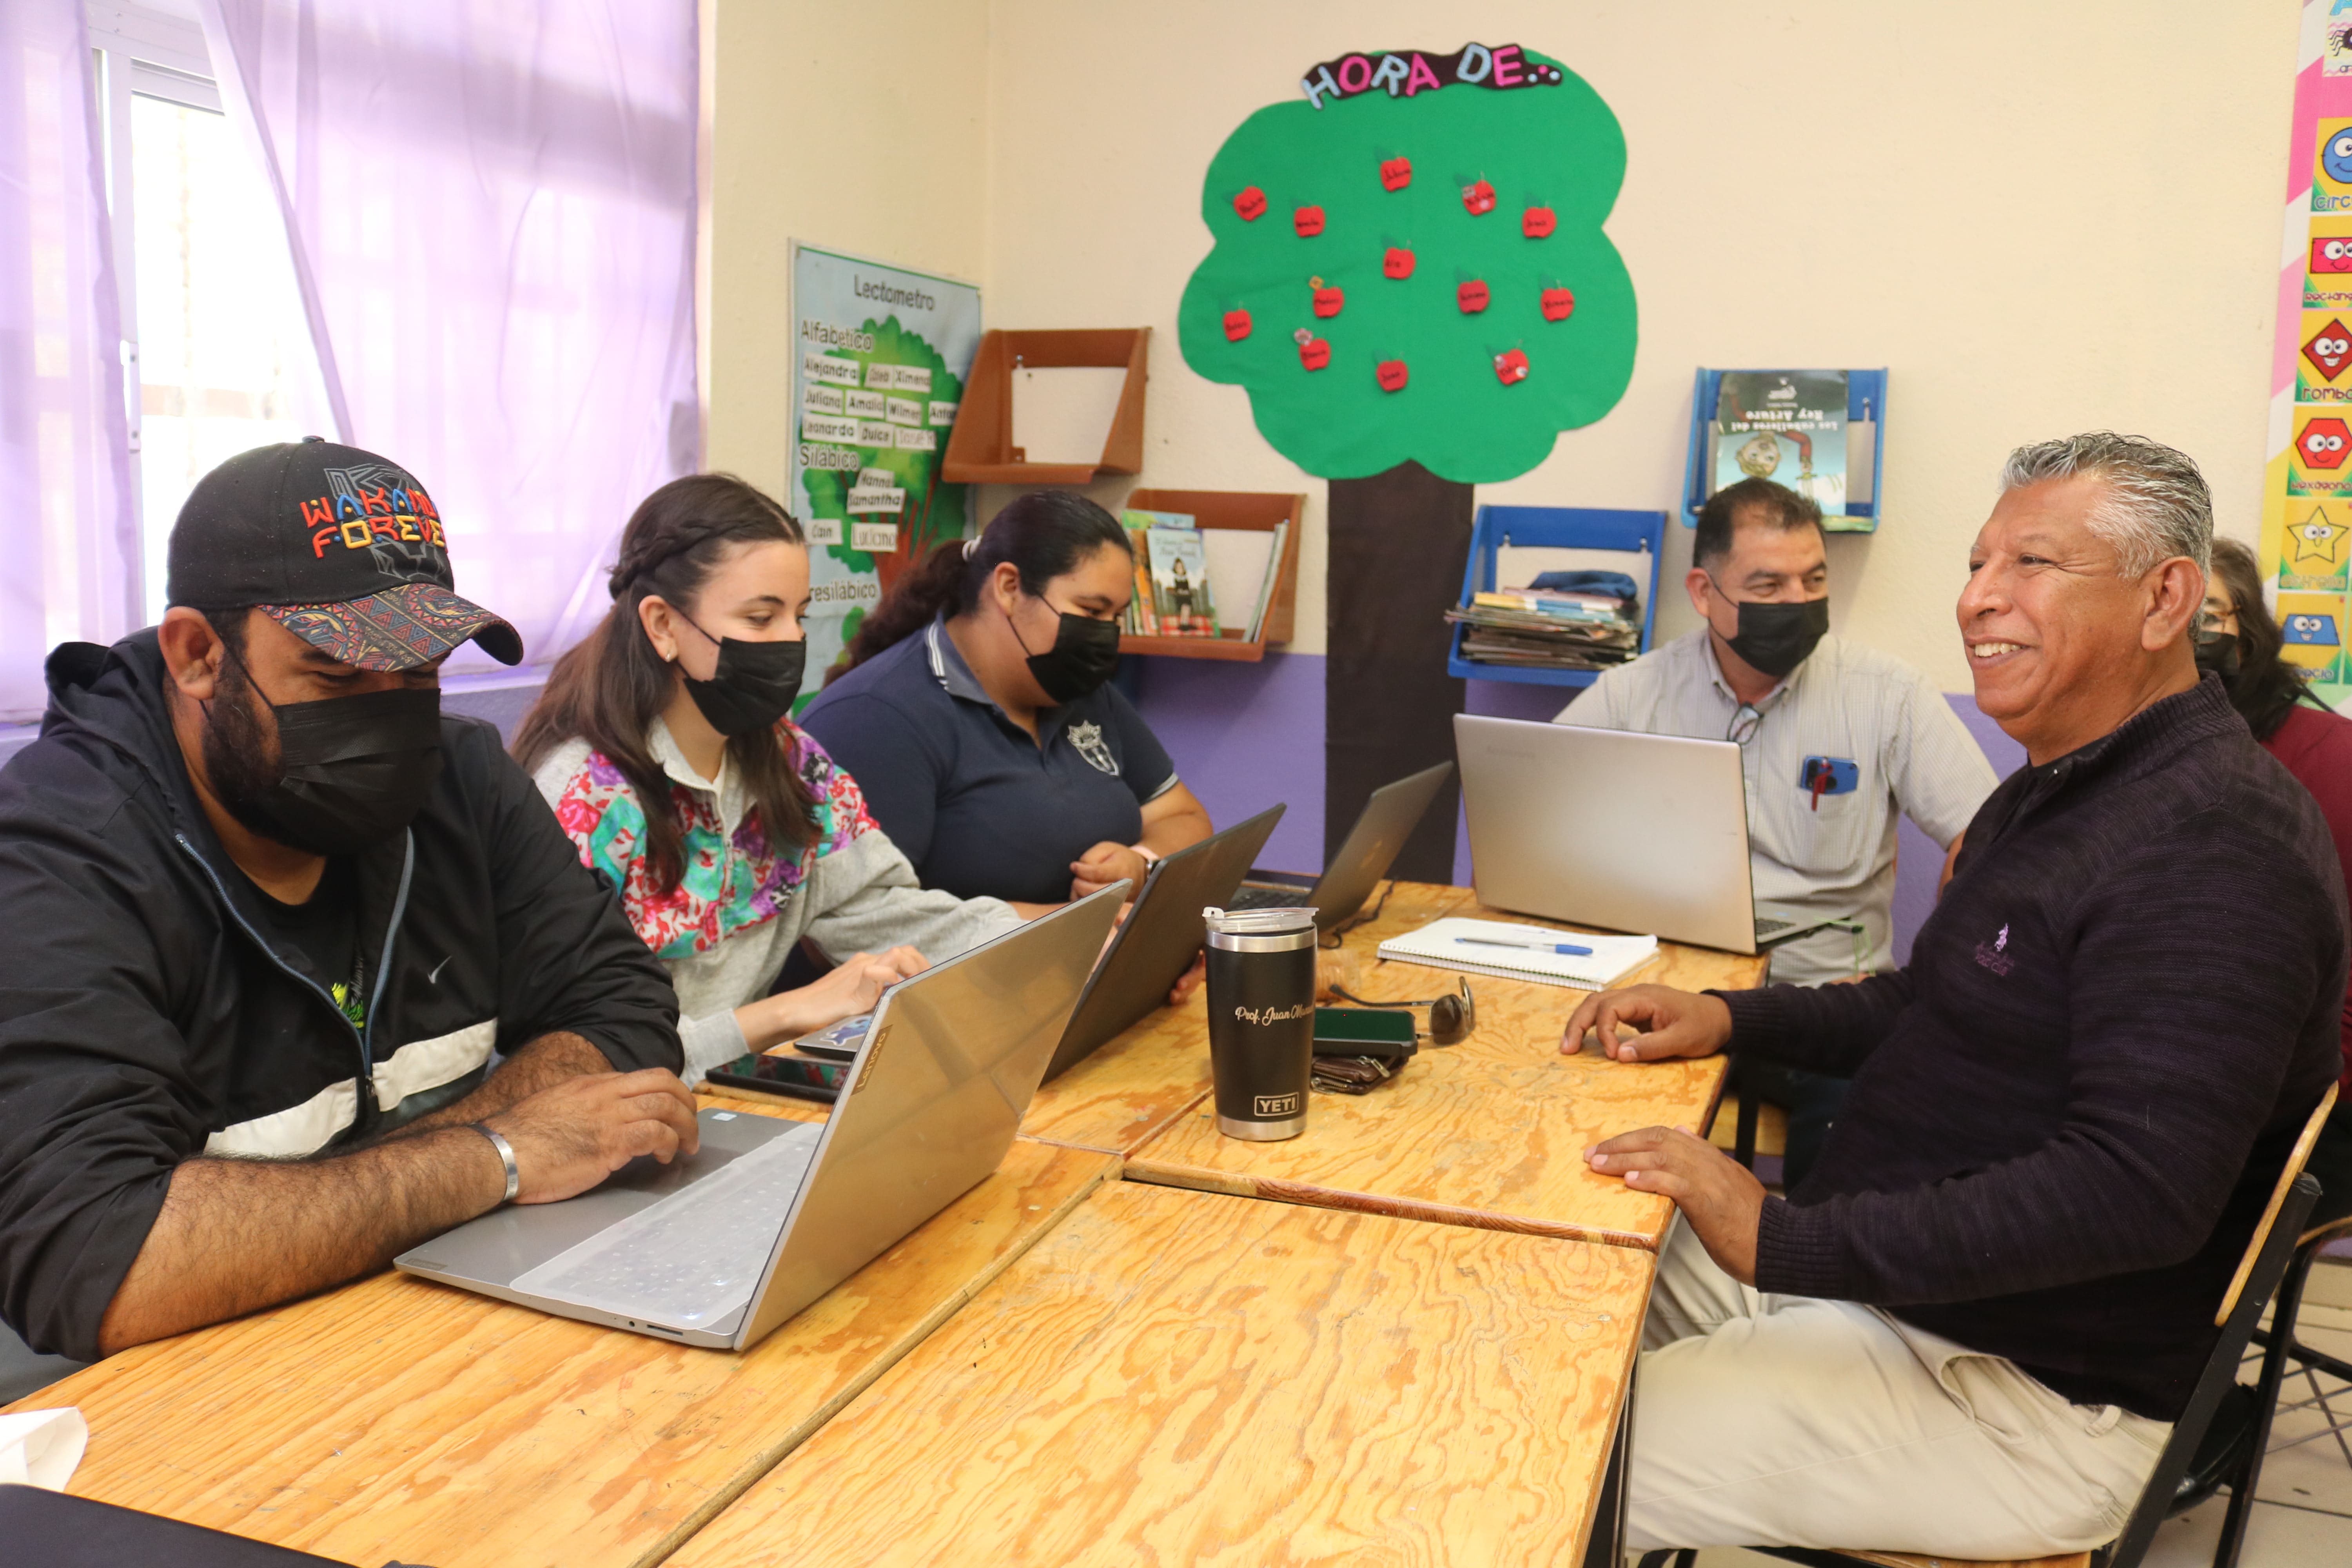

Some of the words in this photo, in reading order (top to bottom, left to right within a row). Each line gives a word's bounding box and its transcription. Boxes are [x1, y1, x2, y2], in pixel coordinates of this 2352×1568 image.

[1301, 53, 1441, 110] HORA
[855, 274, 935, 311] Lectometro
[1746, 410, 1793, 421] Arturo
[1797, 408, 1824, 421] Rey
[299, 487, 441, 529] WAKAND
[312, 514, 448, 558] FOREVE
[809, 580, 876, 602] resilábico
[1235, 1006, 1260, 1025] Prof.
[1262, 1006, 1291, 1026] Juan
[857, 1032, 887, 1088] Lenovo
[1259, 1097, 1295, 1113] YETI
